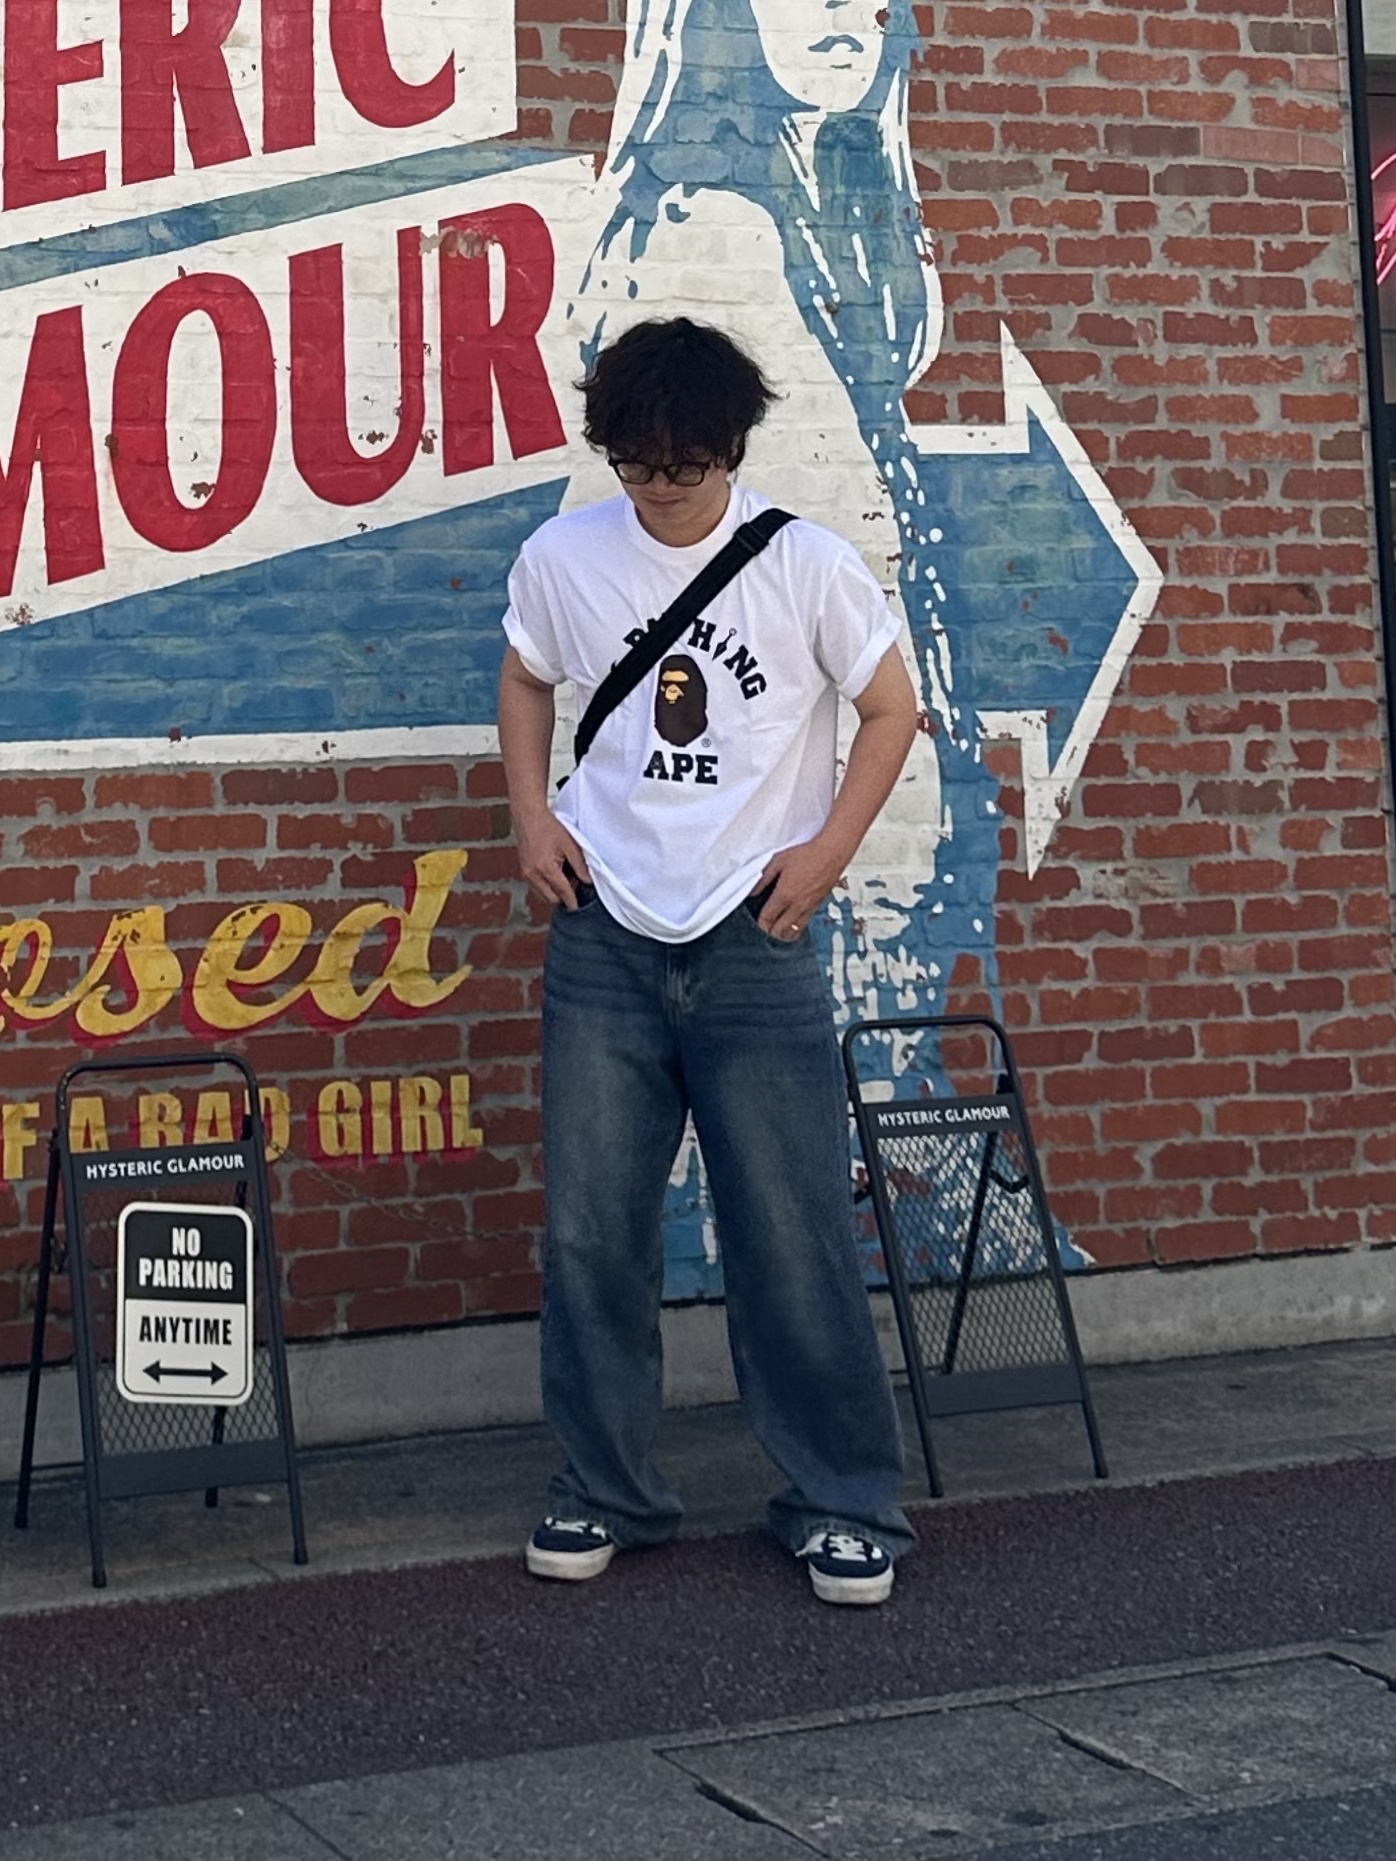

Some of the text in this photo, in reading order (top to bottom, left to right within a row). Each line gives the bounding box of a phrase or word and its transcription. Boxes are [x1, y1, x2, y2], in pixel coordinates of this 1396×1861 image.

[623, 612, 767, 700] BHING
[643, 750, 718, 785] APE
[68, 1096, 110, 1154] A
[318, 1073, 483, 1157] GIRL
[877, 1105, 1011, 1127] HYSTERIC GLAMOUR
[86, 1153, 245, 1180] HYSTERIC GLAMOUR
[171, 1226, 201, 1257] NO
[138, 1257, 234, 1291] PARKING
[139, 1315, 232, 1346] ANYTIME
